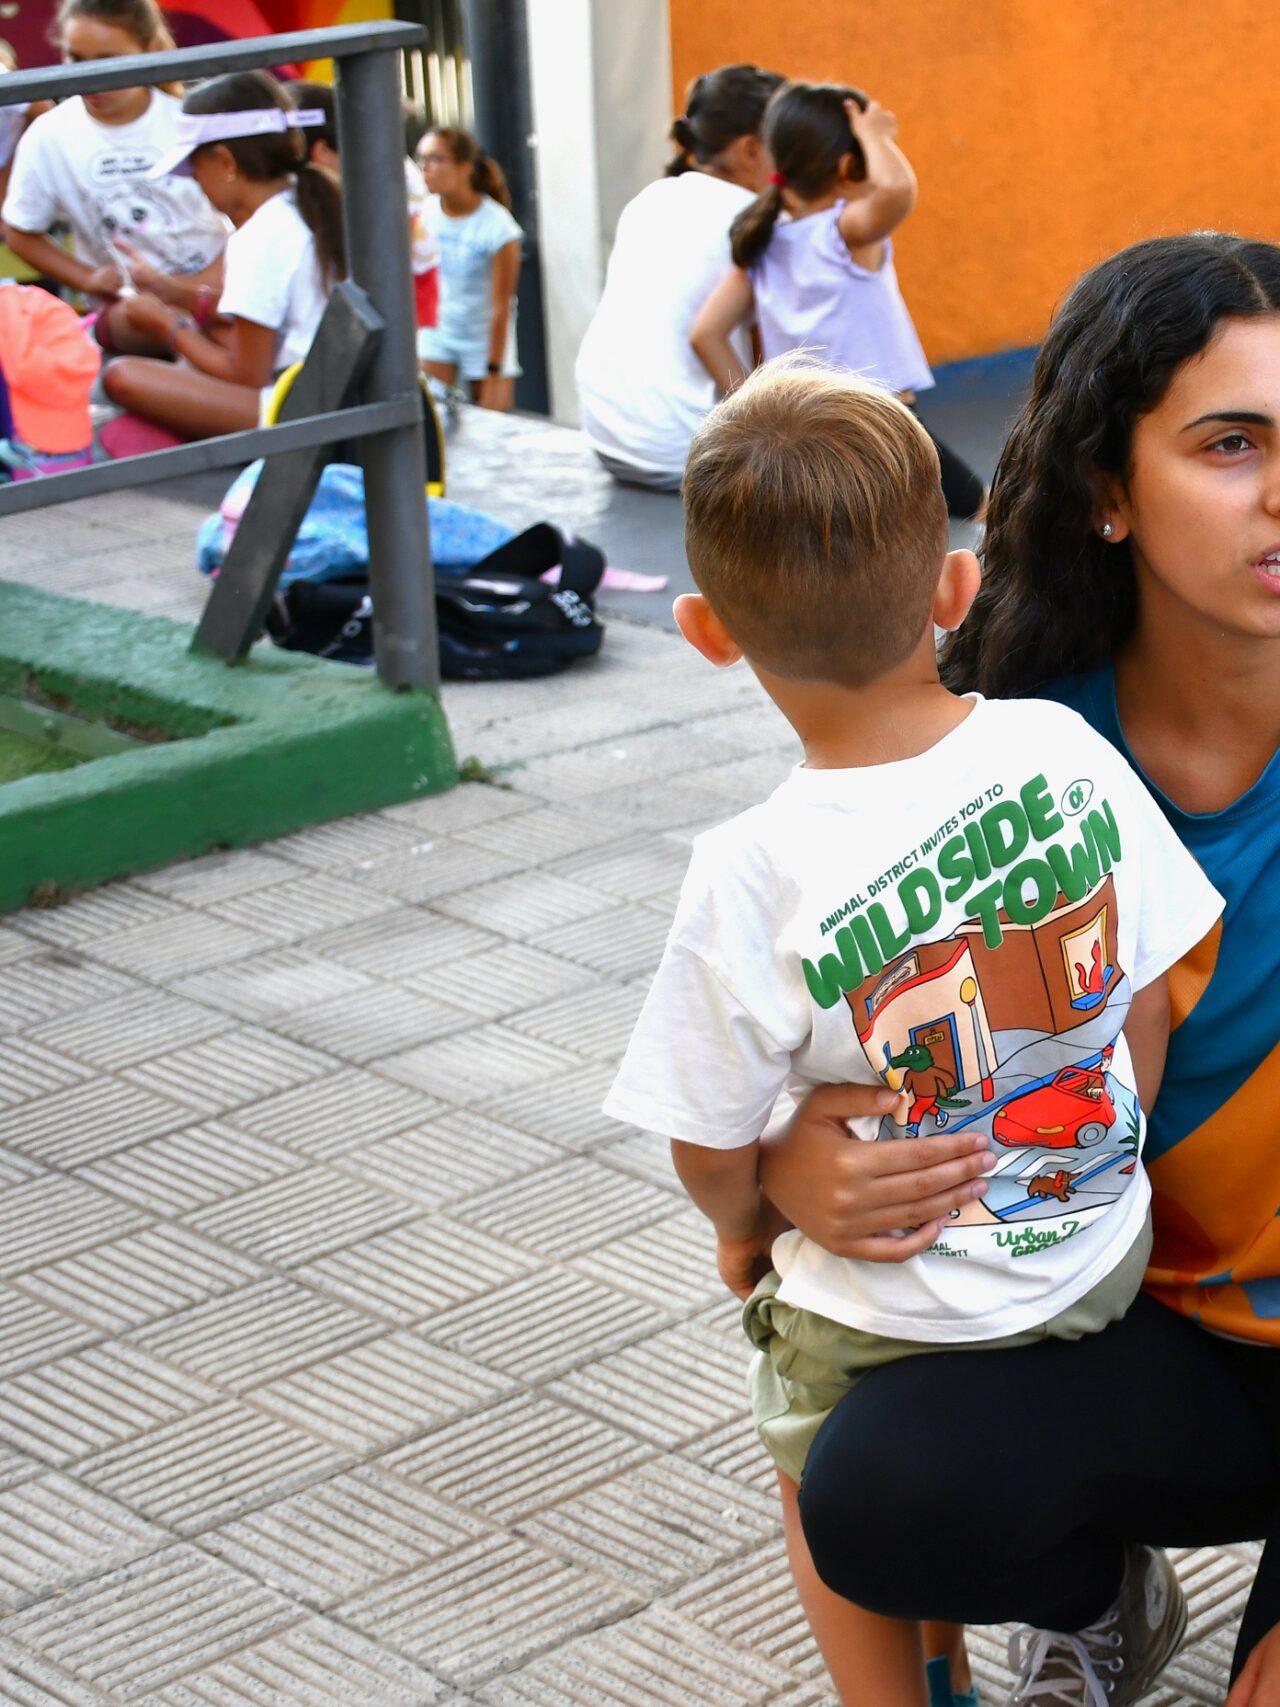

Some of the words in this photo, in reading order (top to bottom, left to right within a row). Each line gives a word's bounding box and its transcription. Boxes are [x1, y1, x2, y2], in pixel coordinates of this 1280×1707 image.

[819, 893, 867, 936] ANIMAL
[867, 849, 919, 897] DISTRICT
[920, 816, 959, 857] INVITES
[959, 796, 984, 821] YOU
[985, 783, 1004, 802] TO
[965, 798, 1122, 950] TOWN
[991, 1226, 1060, 1247] Urban
